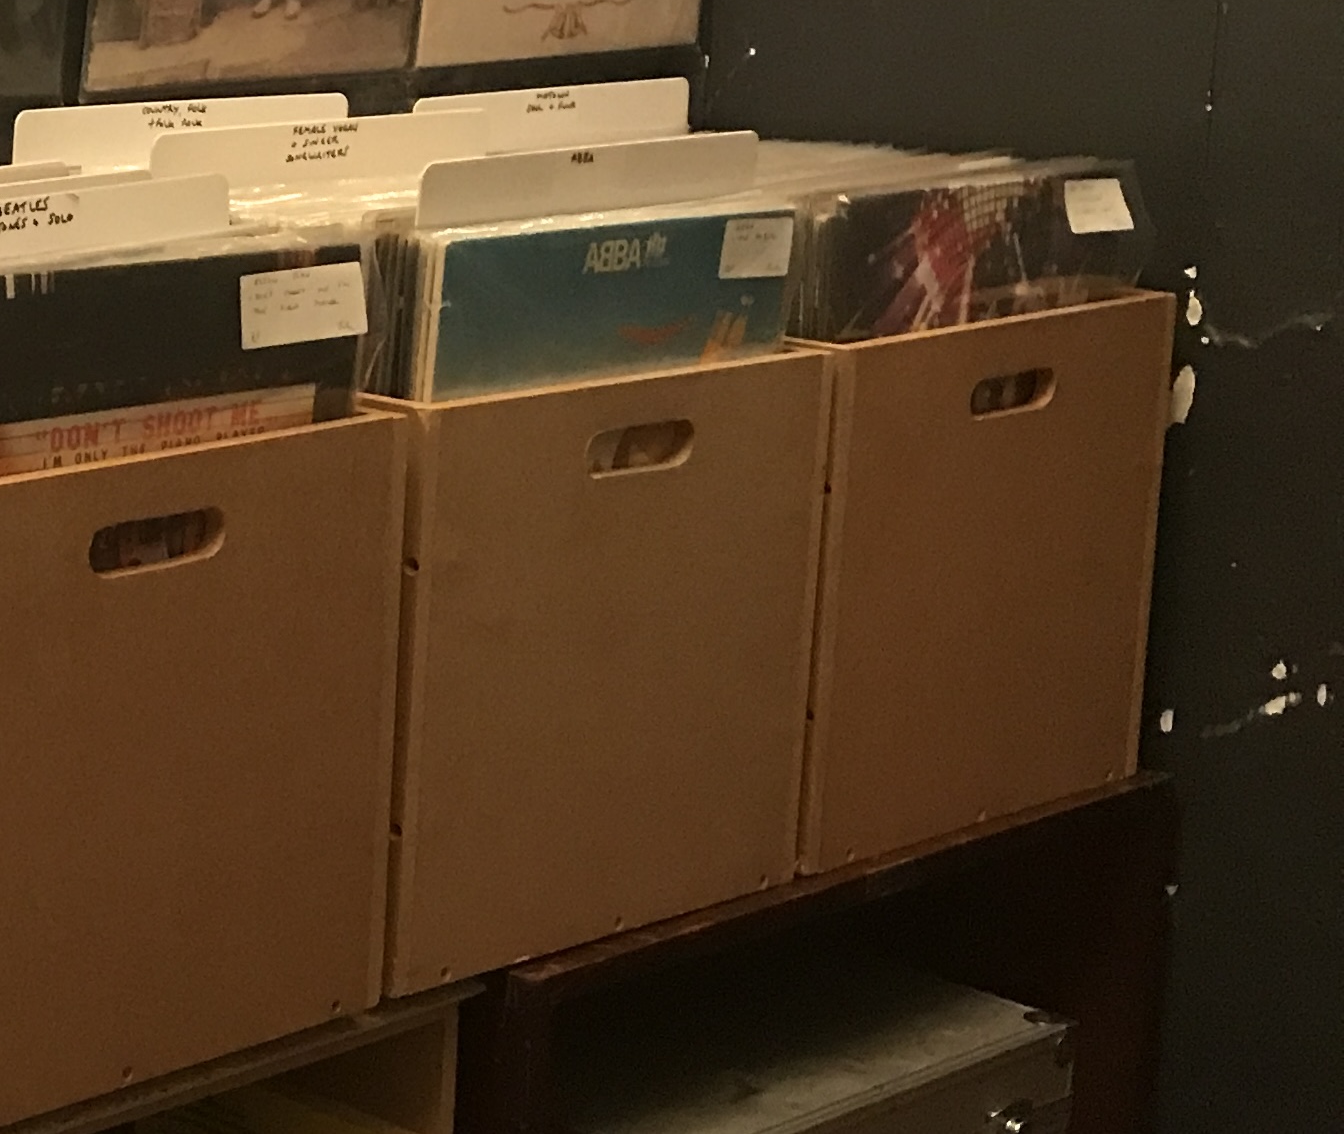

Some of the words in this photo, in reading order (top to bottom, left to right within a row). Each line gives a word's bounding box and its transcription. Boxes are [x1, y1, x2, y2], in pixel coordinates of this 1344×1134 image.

[581, 237, 642, 275] ABBA
[142, 406, 216, 441] SHOOT
[73, 449, 109, 466] ONLY
